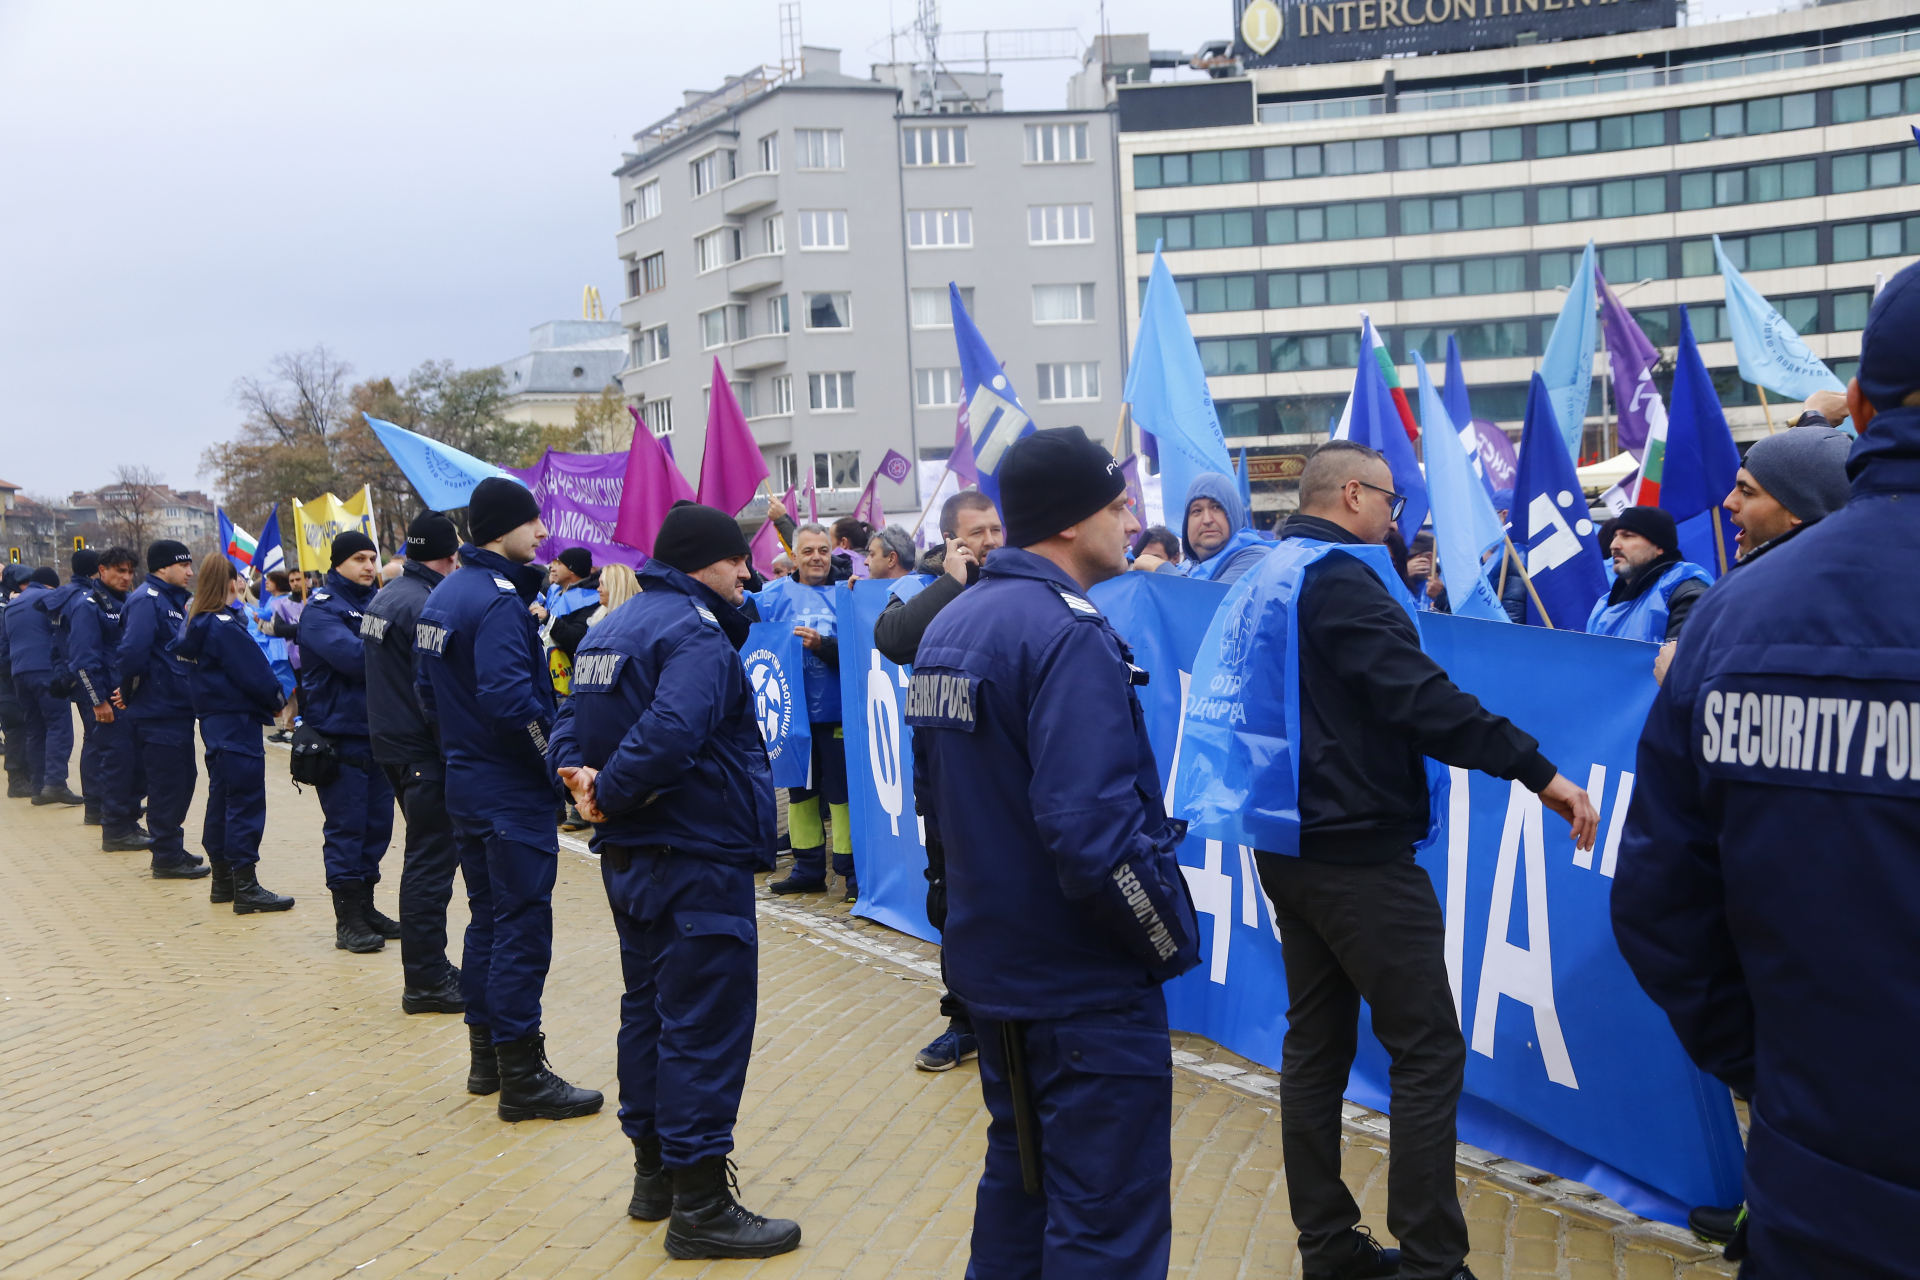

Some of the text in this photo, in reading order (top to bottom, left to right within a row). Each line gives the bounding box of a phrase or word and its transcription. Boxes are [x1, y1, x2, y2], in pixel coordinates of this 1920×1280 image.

[777, 670, 793, 739] РАБОТНИЦИ
[1702, 690, 1862, 774] SECURITY
[1112, 863, 1178, 961] SECURITY POLICE
